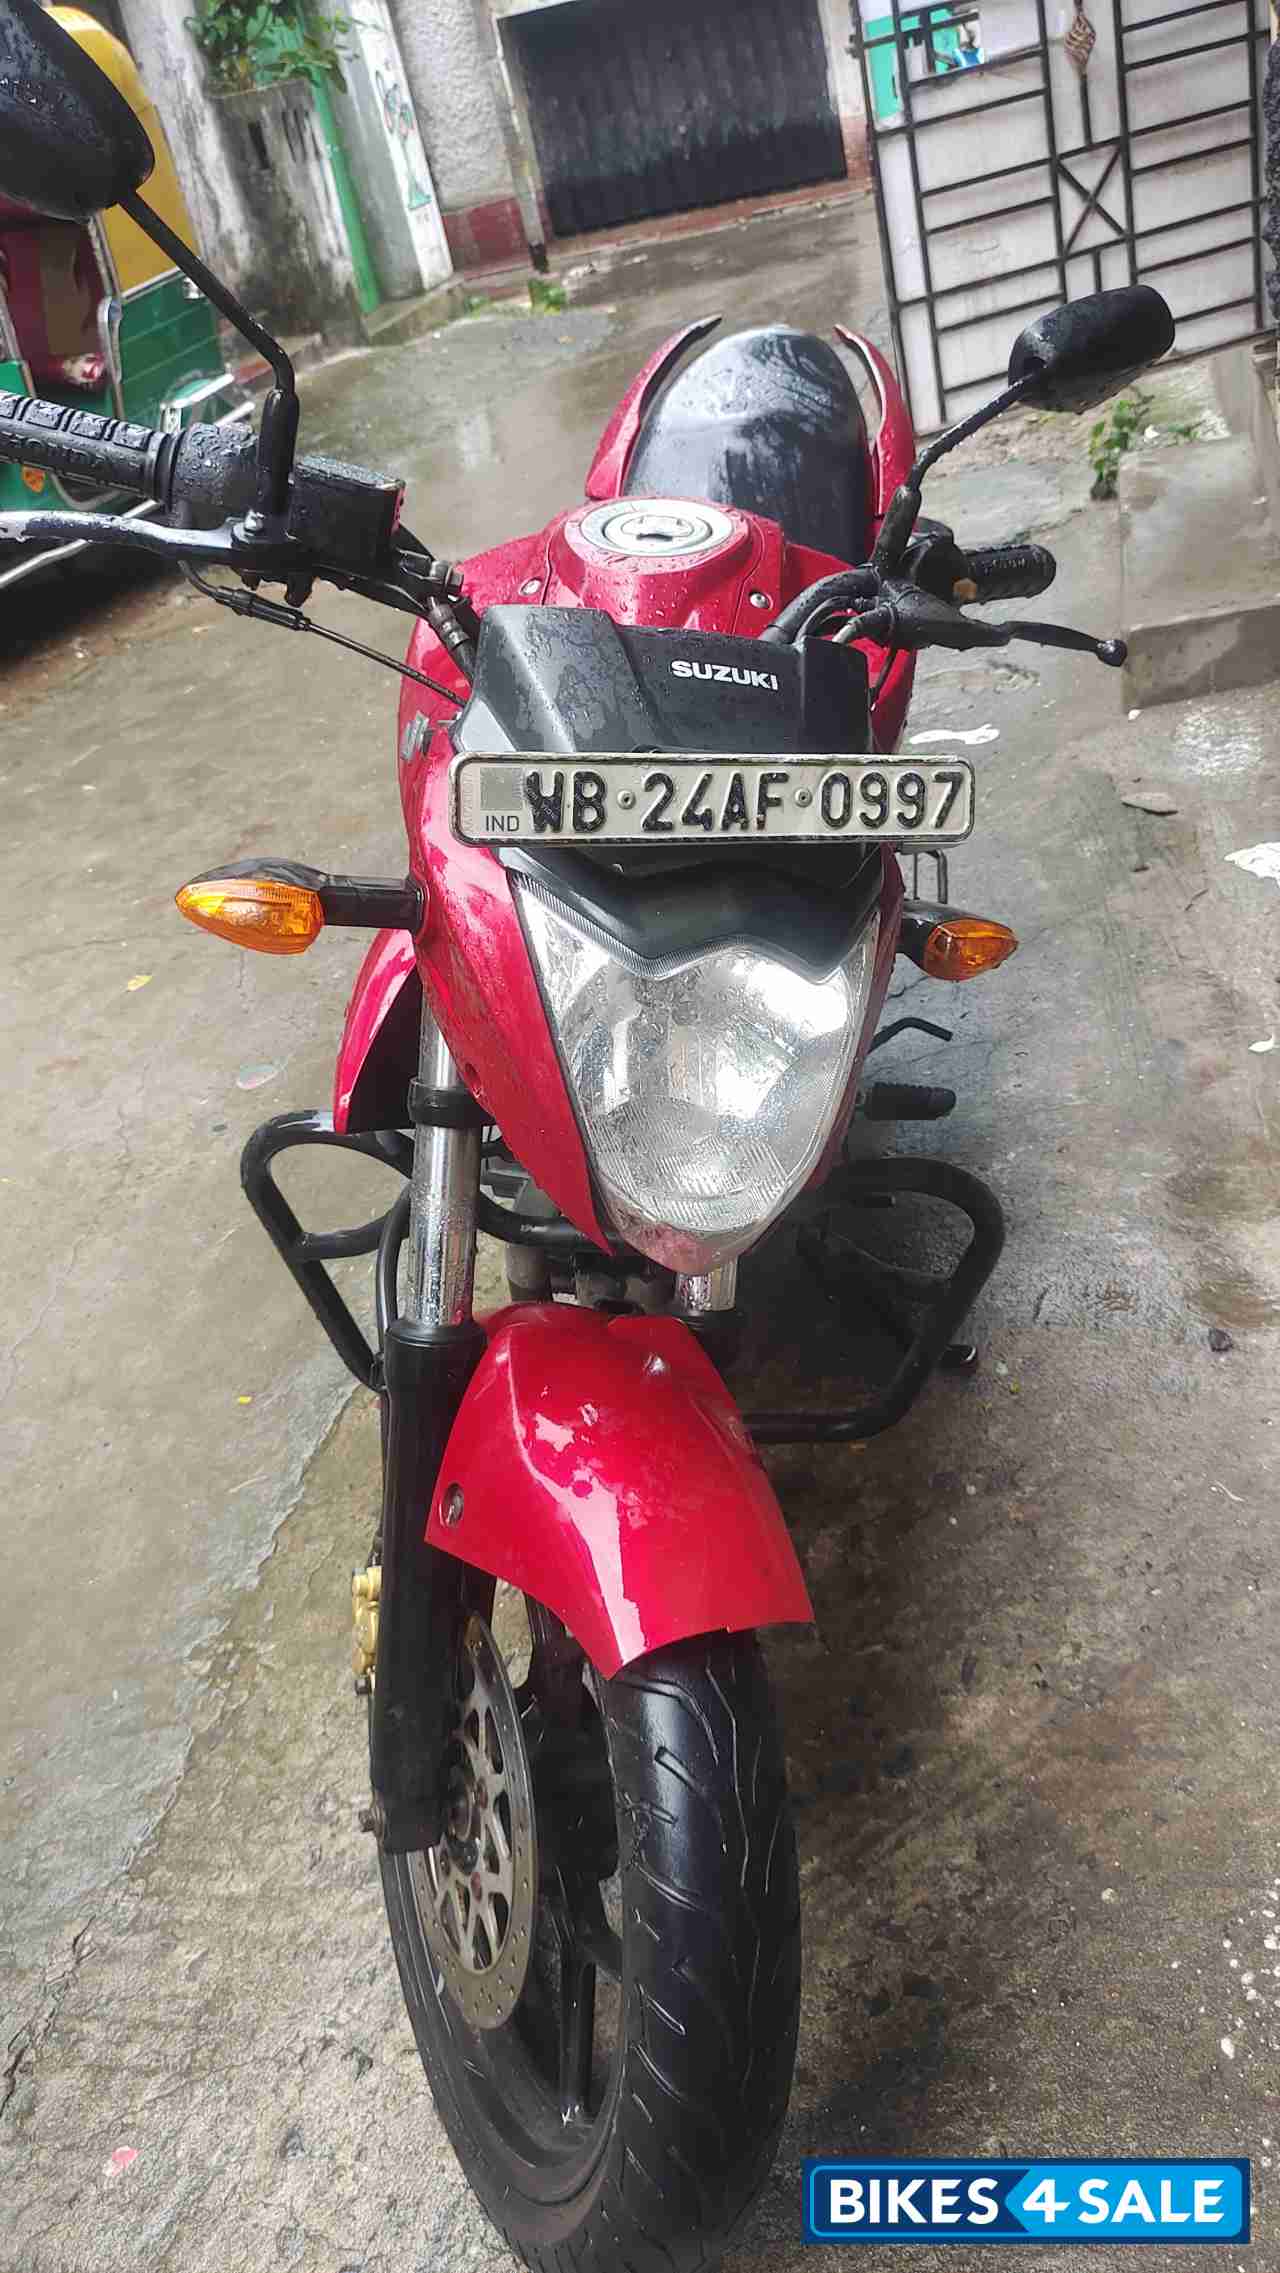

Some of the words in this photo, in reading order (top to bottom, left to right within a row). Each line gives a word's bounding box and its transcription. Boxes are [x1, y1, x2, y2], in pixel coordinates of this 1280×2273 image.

[671, 660, 779, 691] SUZUKI
[522, 771, 607, 834] WB
[642, 772, 790, 833] 24AF
[820, 771, 964, 830] 0997
[485, 815, 520, 832] IND
